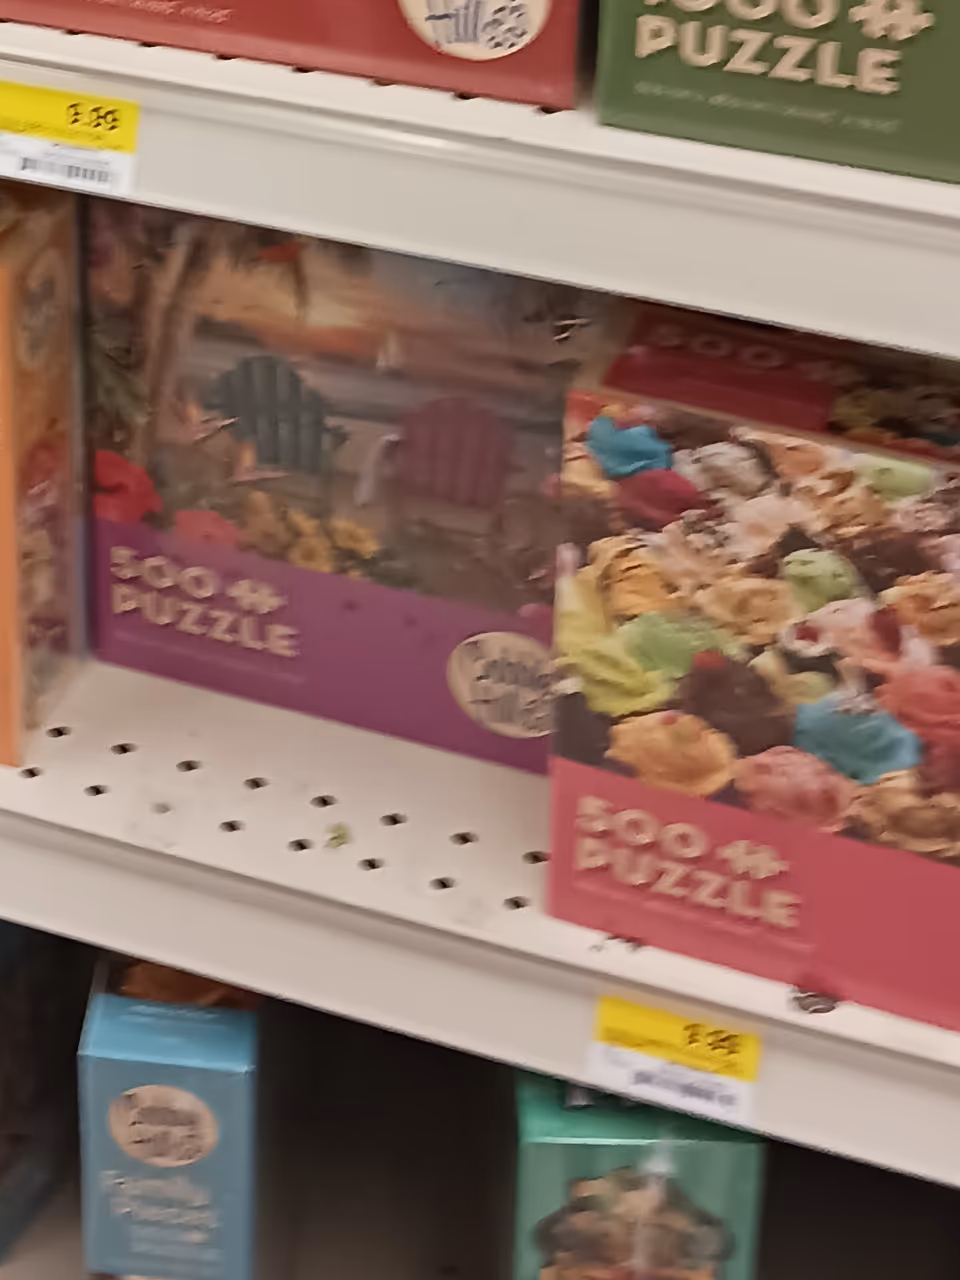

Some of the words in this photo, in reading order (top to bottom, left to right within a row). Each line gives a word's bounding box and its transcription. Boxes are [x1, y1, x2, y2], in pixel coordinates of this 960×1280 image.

[634, 13, 904, 96] PUZZLE
[111, 581, 303, 669] PUZZLE
[575, 835, 804, 929] PUZZLE
